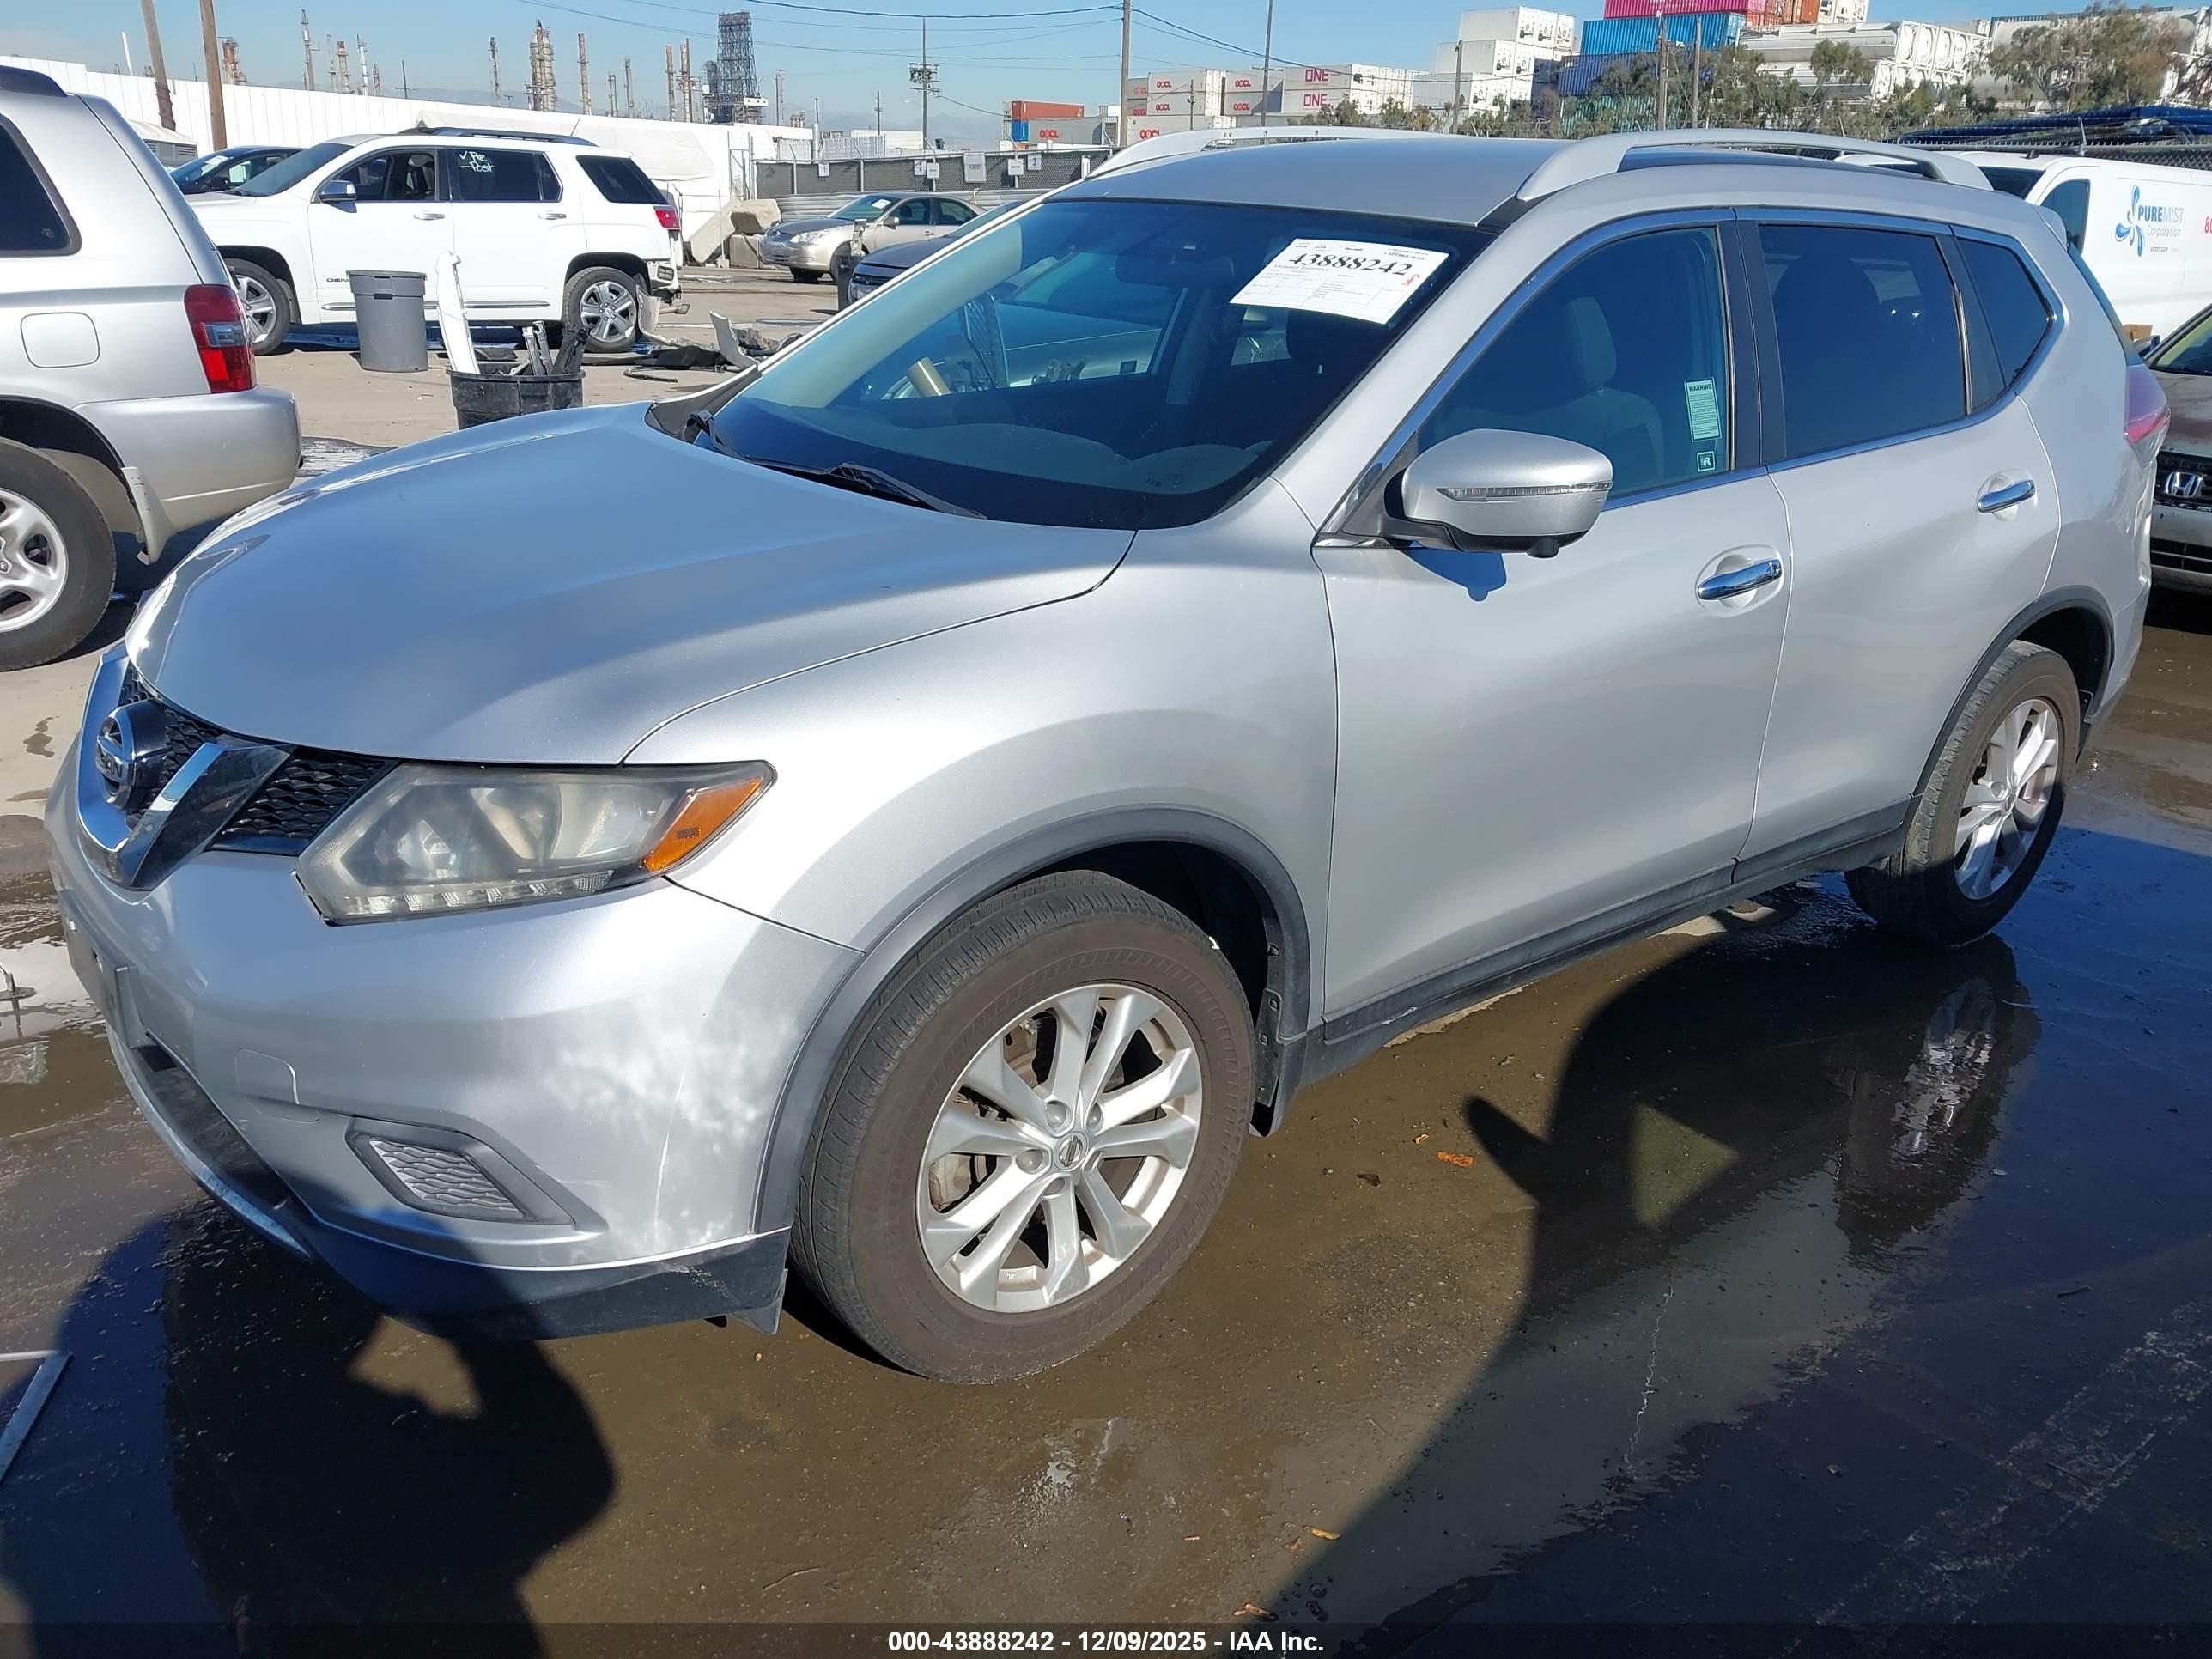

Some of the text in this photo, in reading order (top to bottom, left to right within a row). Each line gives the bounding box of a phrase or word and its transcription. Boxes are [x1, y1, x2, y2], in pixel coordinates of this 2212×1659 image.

[1305, 69, 1329, 82] ONE
[1304, 94, 1328, 106] ONE
[1155, 103, 1170, 112] OOCL
[1039, 129, 1059, 138] OOCL
[469, 161, 495, 173] Post
[1289, 253, 1413, 276] 43888242
[1688, 383, 1712, 392] WARNING
